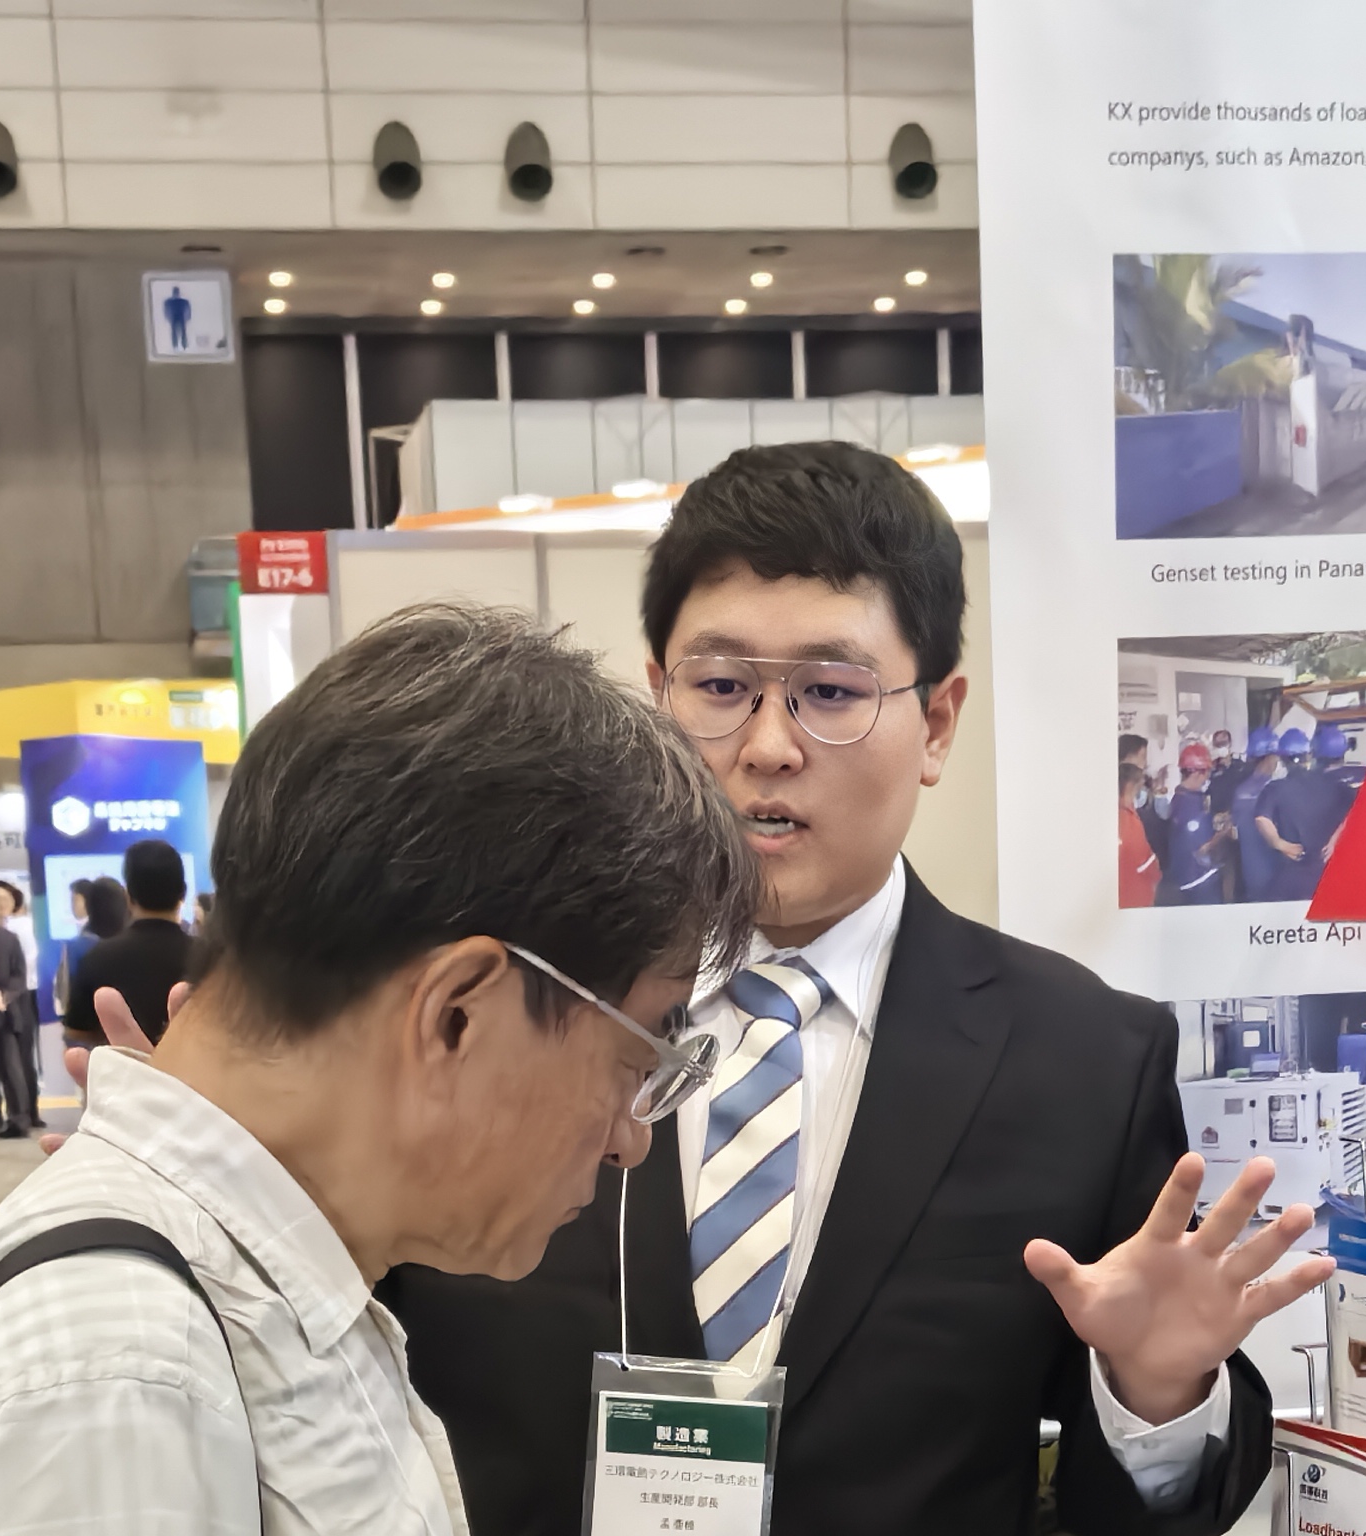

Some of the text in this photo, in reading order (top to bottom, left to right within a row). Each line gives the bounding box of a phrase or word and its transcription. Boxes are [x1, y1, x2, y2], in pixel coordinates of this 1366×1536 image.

[1108, 102, 1133, 121] KX
[1139, 101, 1211, 126] provide
[1216, 101, 1312, 122] thousands
[1317, 101, 1336, 121] of
[1108, 149, 1209, 172] companys,
[1216, 146, 1257, 166] such
[1264, 150, 1283, 166] as
[1151, 563, 1217, 583] Genset
[1223, 561, 1288, 586] testing
[1294, 559, 1311, 579] in
[1249, 925, 1318, 945] Kereta
